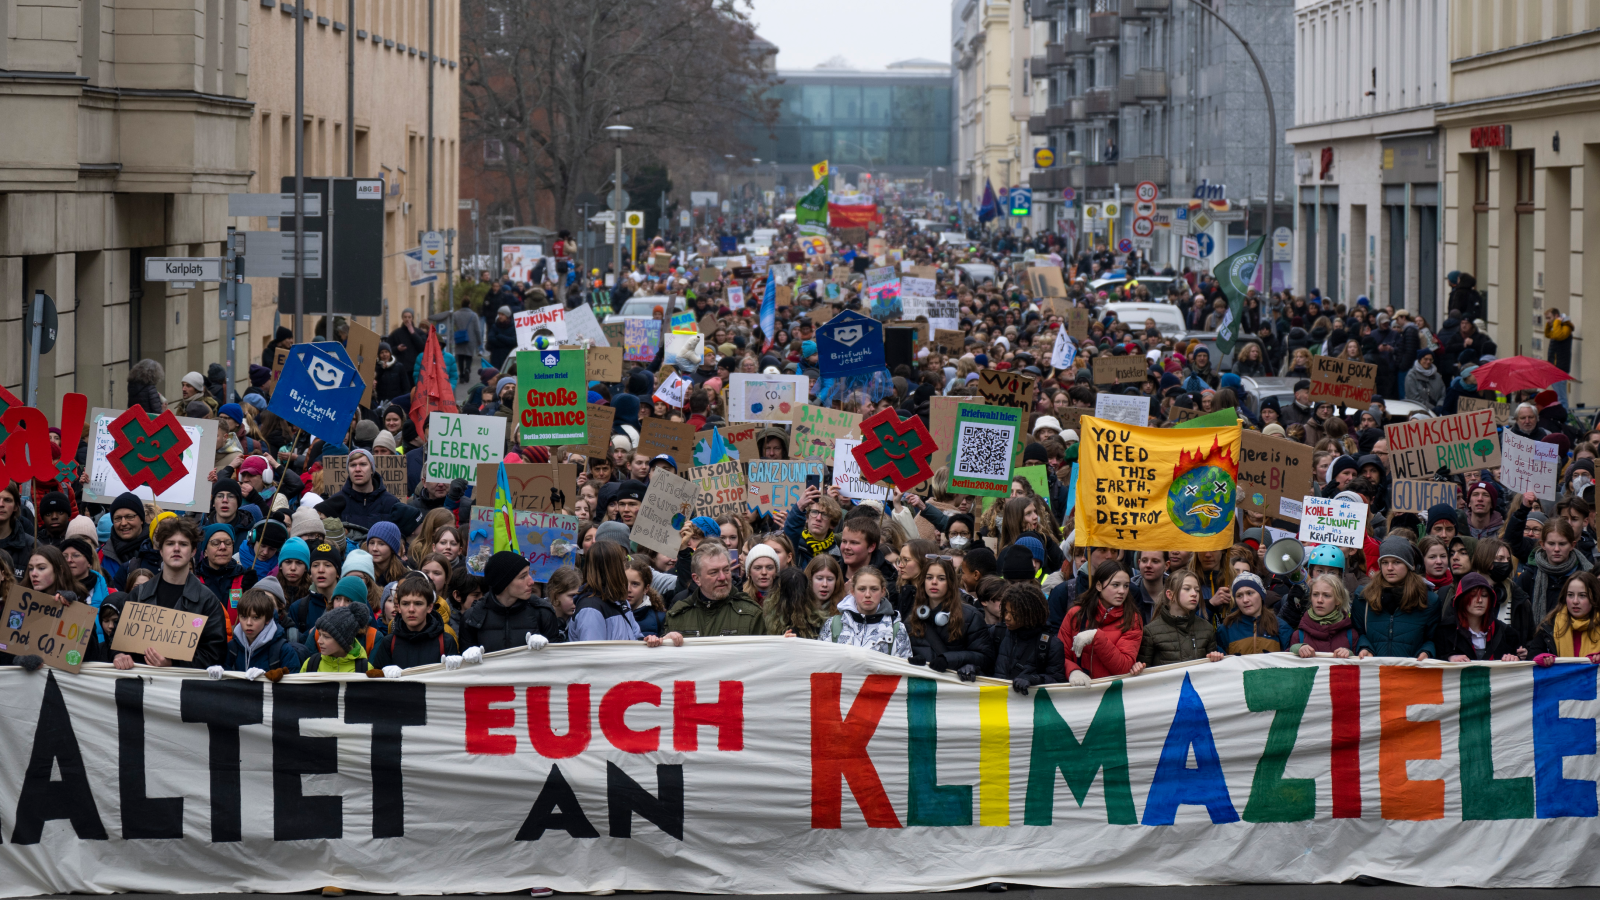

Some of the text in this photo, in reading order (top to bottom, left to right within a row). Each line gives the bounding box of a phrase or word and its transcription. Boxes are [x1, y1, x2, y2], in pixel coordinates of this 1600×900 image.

[1141, 187, 1154, 198] 30
[1195, 179, 1224, 199] dm
[1015, 196, 1025, 208] P
[1153, 213, 1169, 222] dm
[514, 308, 564, 328] ZUKUNFT
[624, 319, 643, 328] THIS
[438, 324, 446, 334] P
[624, 328, 658, 338] WHAT WE
[830, 347, 872, 360] Briefwahl
[534, 372, 554, 380] kleiner
[1116, 367, 1146, 379] Insekten
[1336, 374, 1352, 384] AUF
[1348, 363, 1372, 380] BOCK
[981, 372, 1031, 396] Wir
[1311, 380, 1373, 403] ZUKUNFTSANGST
[290, 388, 336, 422] Briefwahl
[526, 388, 578, 407] Große
[520, 408, 586, 428] Chance
[800, 405, 854, 428] Ich will
[961, 408, 1018, 422] Briefwahl hier:
[438, 416, 462, 438] JA
[810, 423, 836, 438] keine
[1091, 427, 1130, 443] YOU
[1387, 410, 1496, 450] KLIMASCHUTZ
[430, 440, 498, 462] LEBENS-
[1096, 444, 1149, 462] NEED
[1240, 440, 1300, 466] here is no
[1512, 436, 1524, 452] Erde
[1526, 444, 1534, 454] ist
[324, 457, 340, 469] THE
[690, 460, 739, 478] IT'S OUR
[1392, 442, 1474, 480] WEIL BAUM
[1514, 454, 1525, 468] die
[1528, 457, 1552, 475] Hüfte
[380, 470, 404, 482] KILLED
[748, 462, 780, 483] GANZ
[835, 474, 849, 486] NO
[1118, 466, 1157, 481] THIS
[1238, 466, 1286, 493] anet B!
[1502, 465, 1552, 494] Mutter
[1516, 466, 1533, 477] deiner
[952, 478, 1008, 493] berlin2030.org
[1096, 478, 1151, 494] EARTH,
[698, 492, 714, 506] SO
[716, 488, 744, 506] STOP
[772, 484, 800, 508] EIS
[1096, 496, 1149, 508] SO DON'T
[1310, 498, 1331, 506] Steckt
[1393, 480, 1458, 510] GO VEGAN
[648, 494, 678, 514] eure
[736, 501, 748, 514] IT
[1305, 505, 1334, 517] KOHLE
[1348, 511, 1356, 519] die
[562, 517, 576, 530] ins
[1096, 510, 1162, 526] DESTROY
[1316, 516, 1360, 530] ZUKUNFT
[1116, 528, 1138, 540] IT
[1308, 524, 1326, 532] nicht
[1310, 531, 1356, 546] KRAFTWERK
[19, 592, 64, 618] Spread
[130, 604, 187, 628] THERE IS
[10, 630, 30, 646] not
[56, 620, 90, 645] LOVE
[124, 622, 198, 648] NO PLANET B
[464, 680, 744, 760] EUCH
[810, 664, 1599, 829] KLIMAZIELE
[0, 668, 427, 845] ALTET
[514, 760, 684, 841] AN
